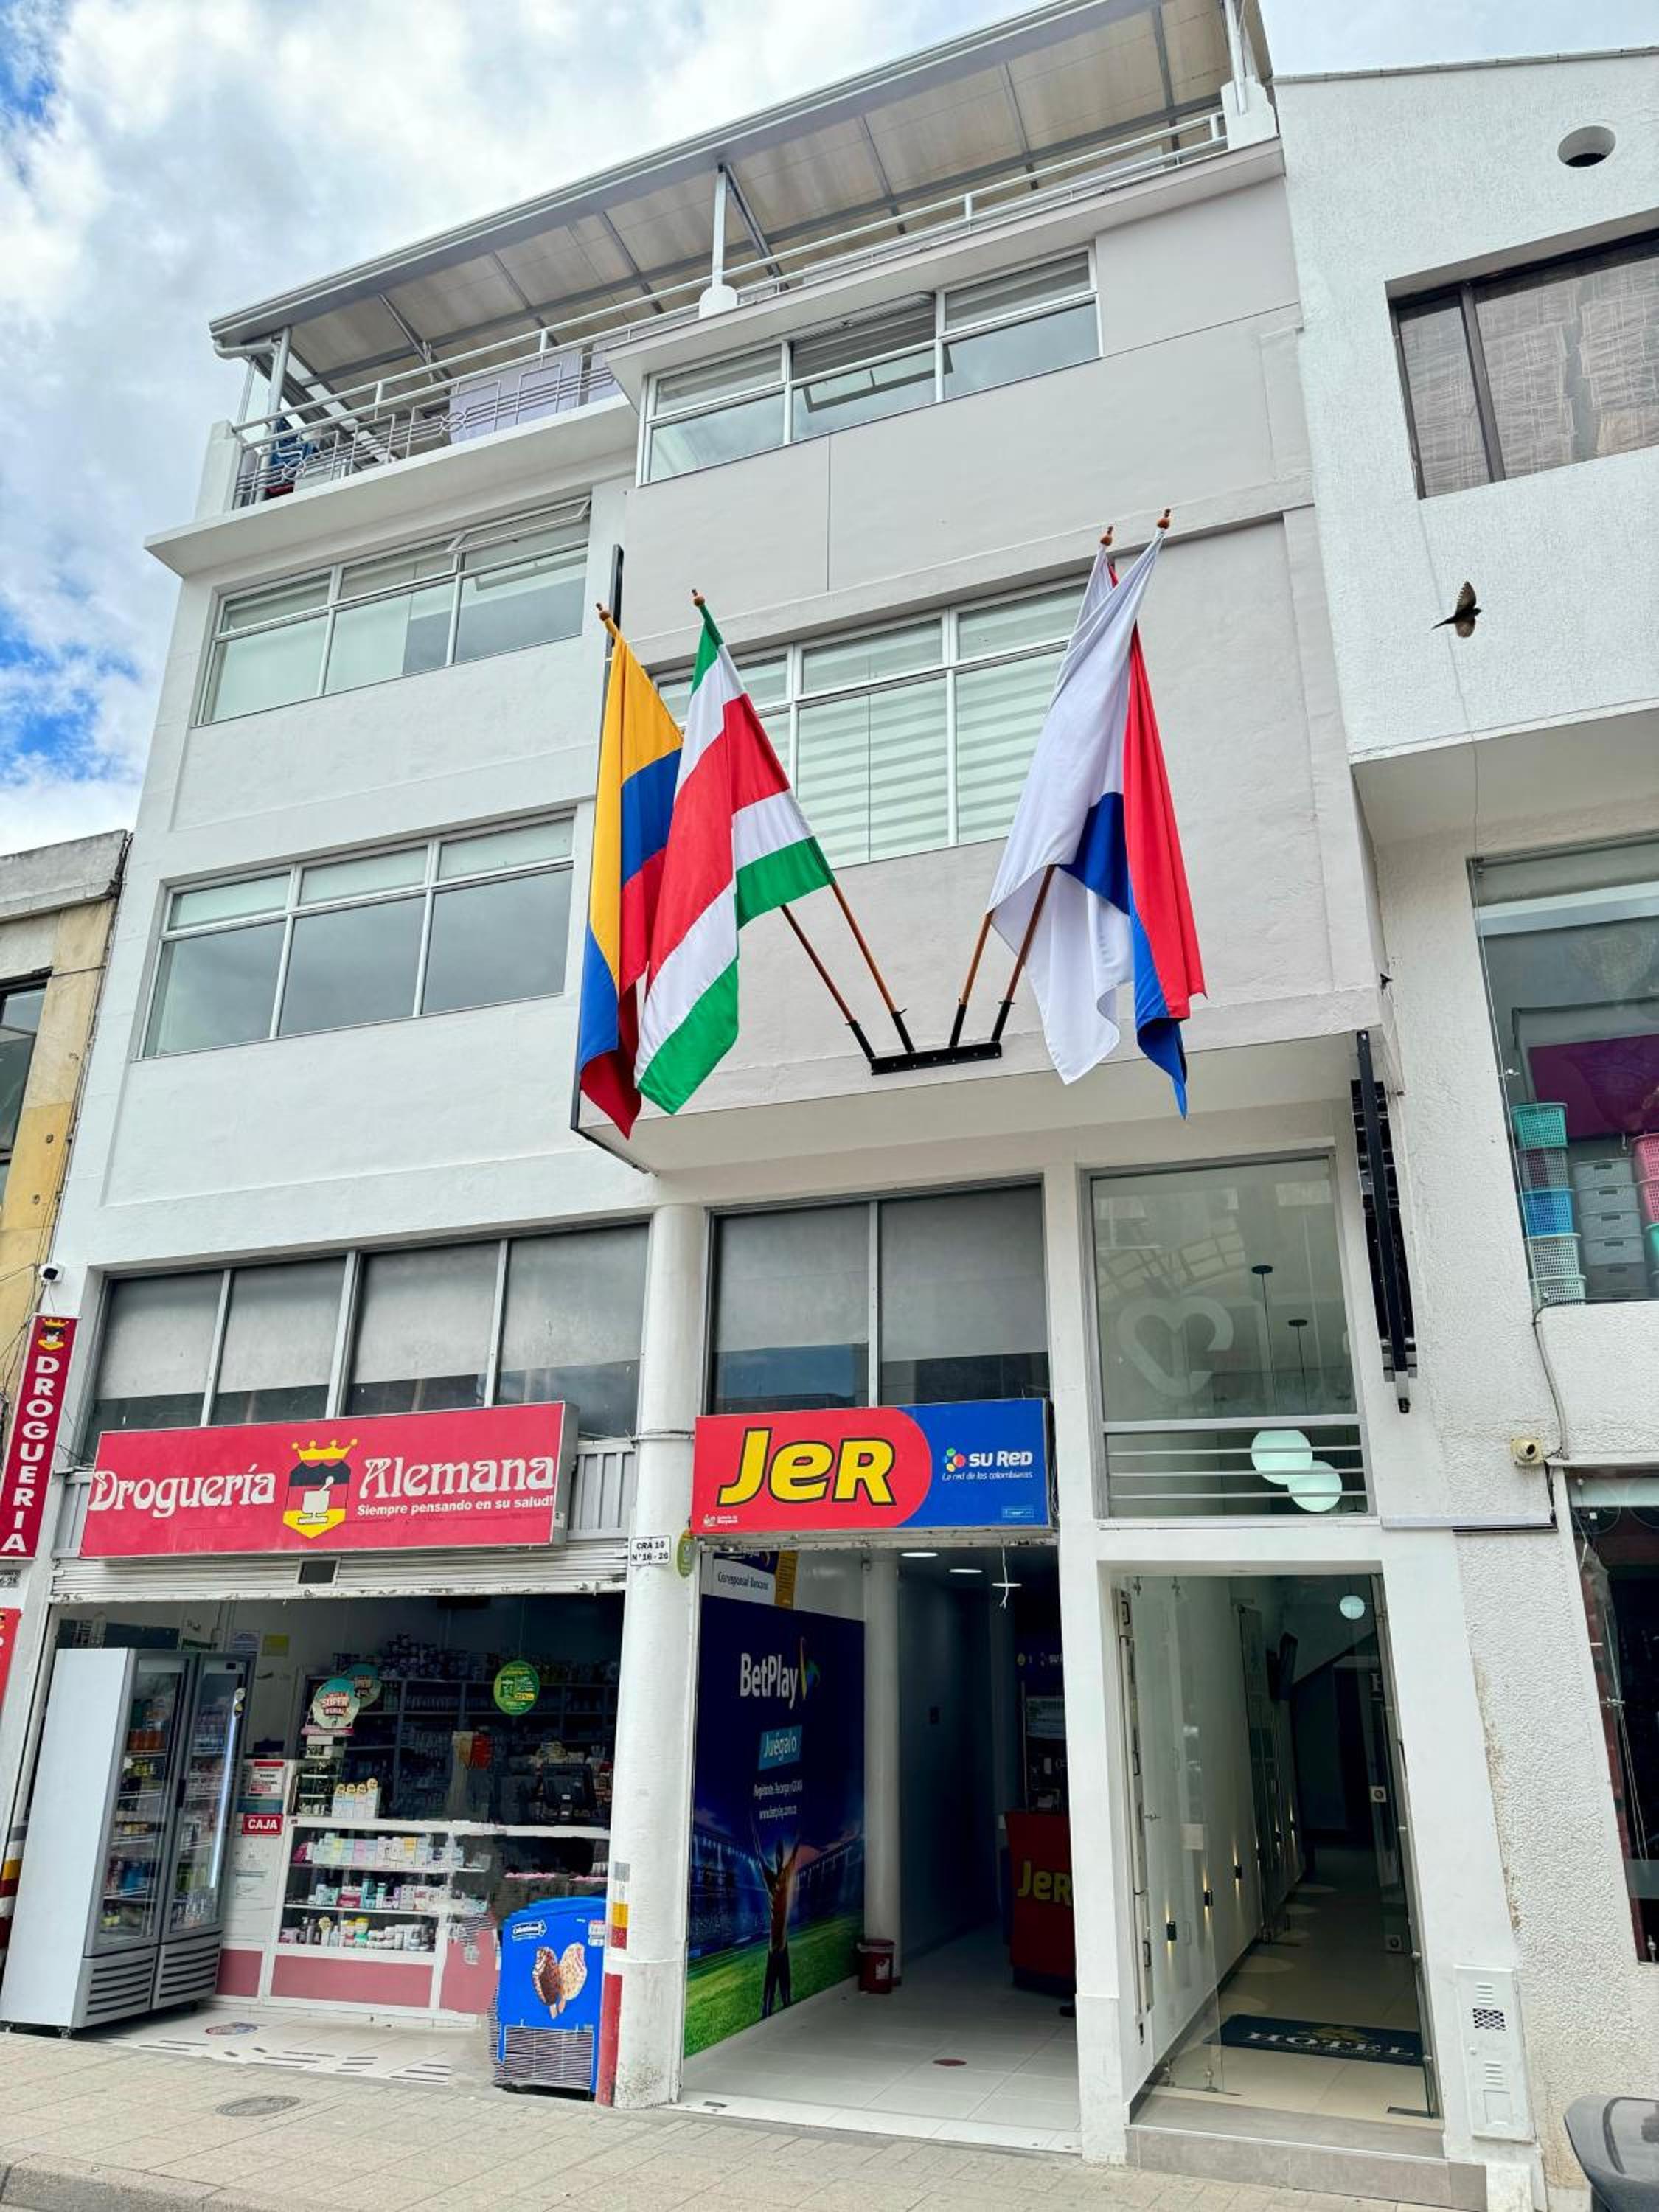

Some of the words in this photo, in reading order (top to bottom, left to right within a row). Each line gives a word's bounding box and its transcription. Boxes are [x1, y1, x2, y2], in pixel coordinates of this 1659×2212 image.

[3, 1356, 60, 1553] DROGUERIA
[717, 1427, 897, 1506] JeR
[88, 1463, 276, 1518] Droguería
[359, 1456, 554, 1499] Alemana
[952, 1472, 965, 1480] red
[966, 1472, 975, 1480] de
[357, 1503, 407, 1517] Siempre
[411, 1500, 472, 1516] pensando
[476, 1500, 492, 1510] en
[495, 1499, 510, 1509] su
[514, 1495, 554, 1509] salud!
[636, 1542, 653, 1550] CRA
[655, 1540, 665, 1549] 10
[740, 1652, 799, 1710] BetPlay
[247, 1818, 278, 1829] CAJA
[1248, 2031, 1415, 2056] HOTEL
